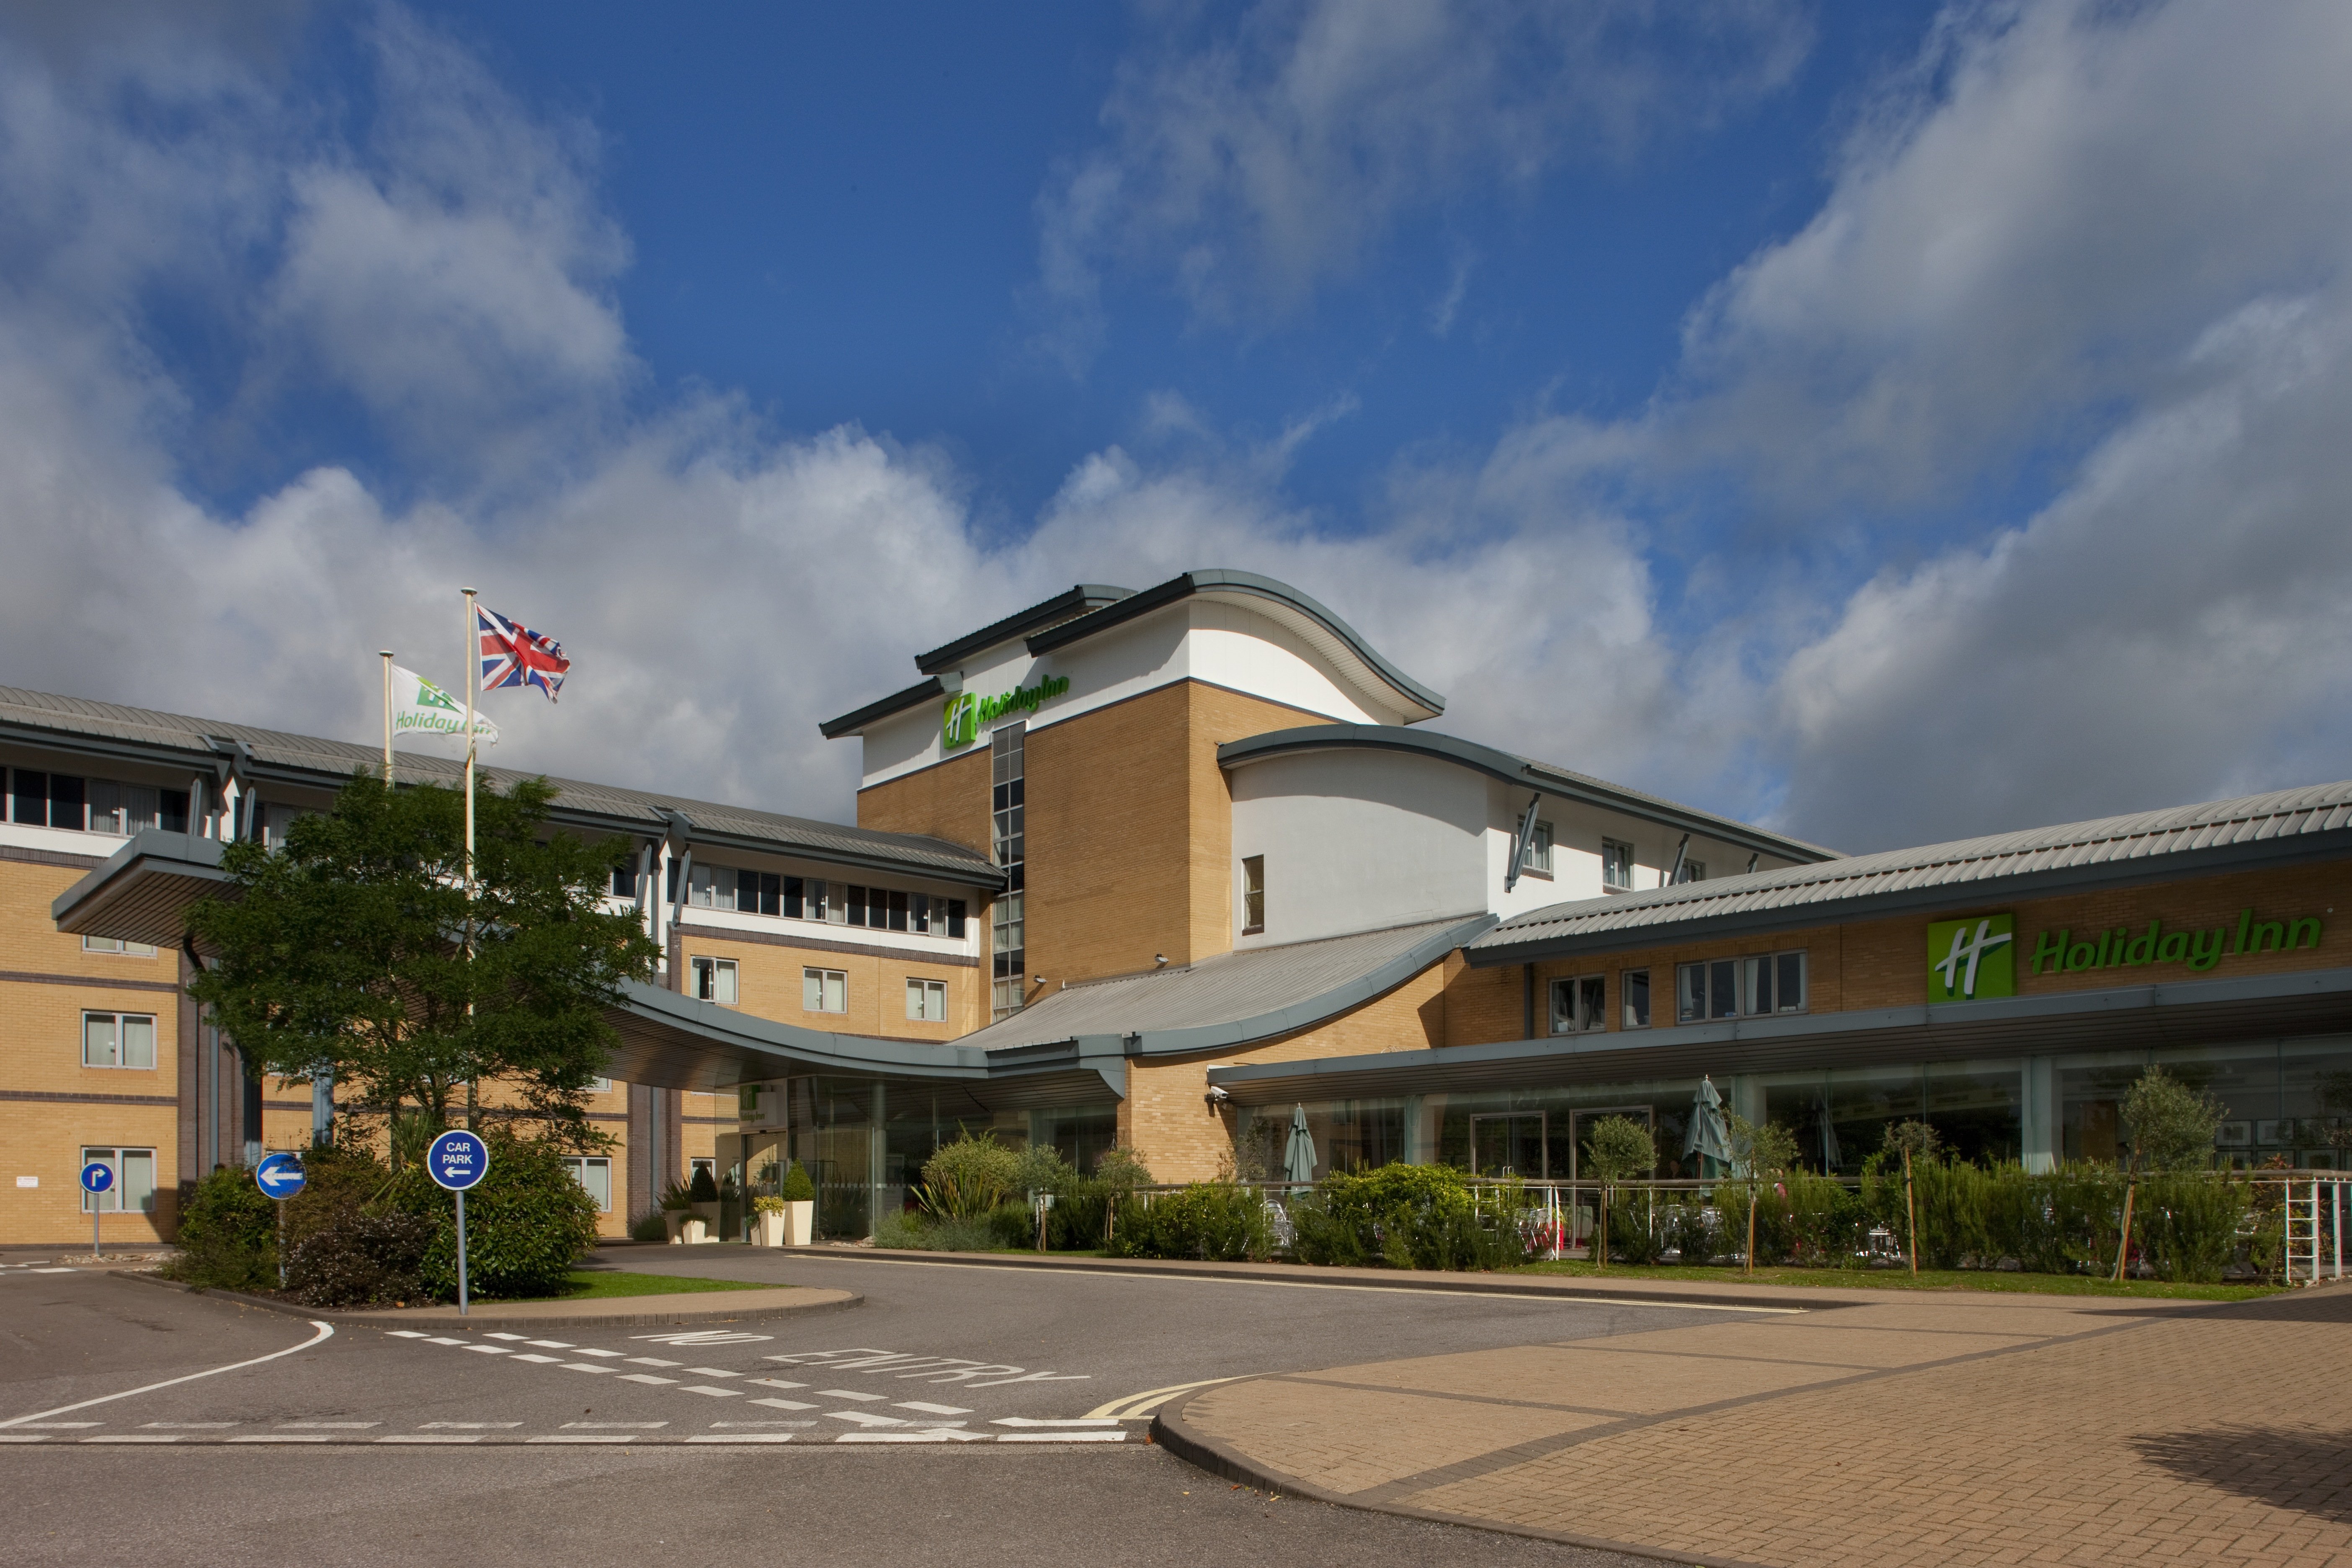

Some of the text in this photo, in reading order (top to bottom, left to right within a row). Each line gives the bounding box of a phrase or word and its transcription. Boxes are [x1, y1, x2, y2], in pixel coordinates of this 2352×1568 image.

[977, 674, 1069, 723] Holiday Inn
[396, 711, 459, 734] Holiday
[2029, 908, 2322, 975] Holiday Inn
[446, 1142, 470, 1152] CAR
[443, 1155, 473, 1164] PARK
[628, 1330, 775, 1346] NO
[761, 1348, 1091, 1388] ENTRY
